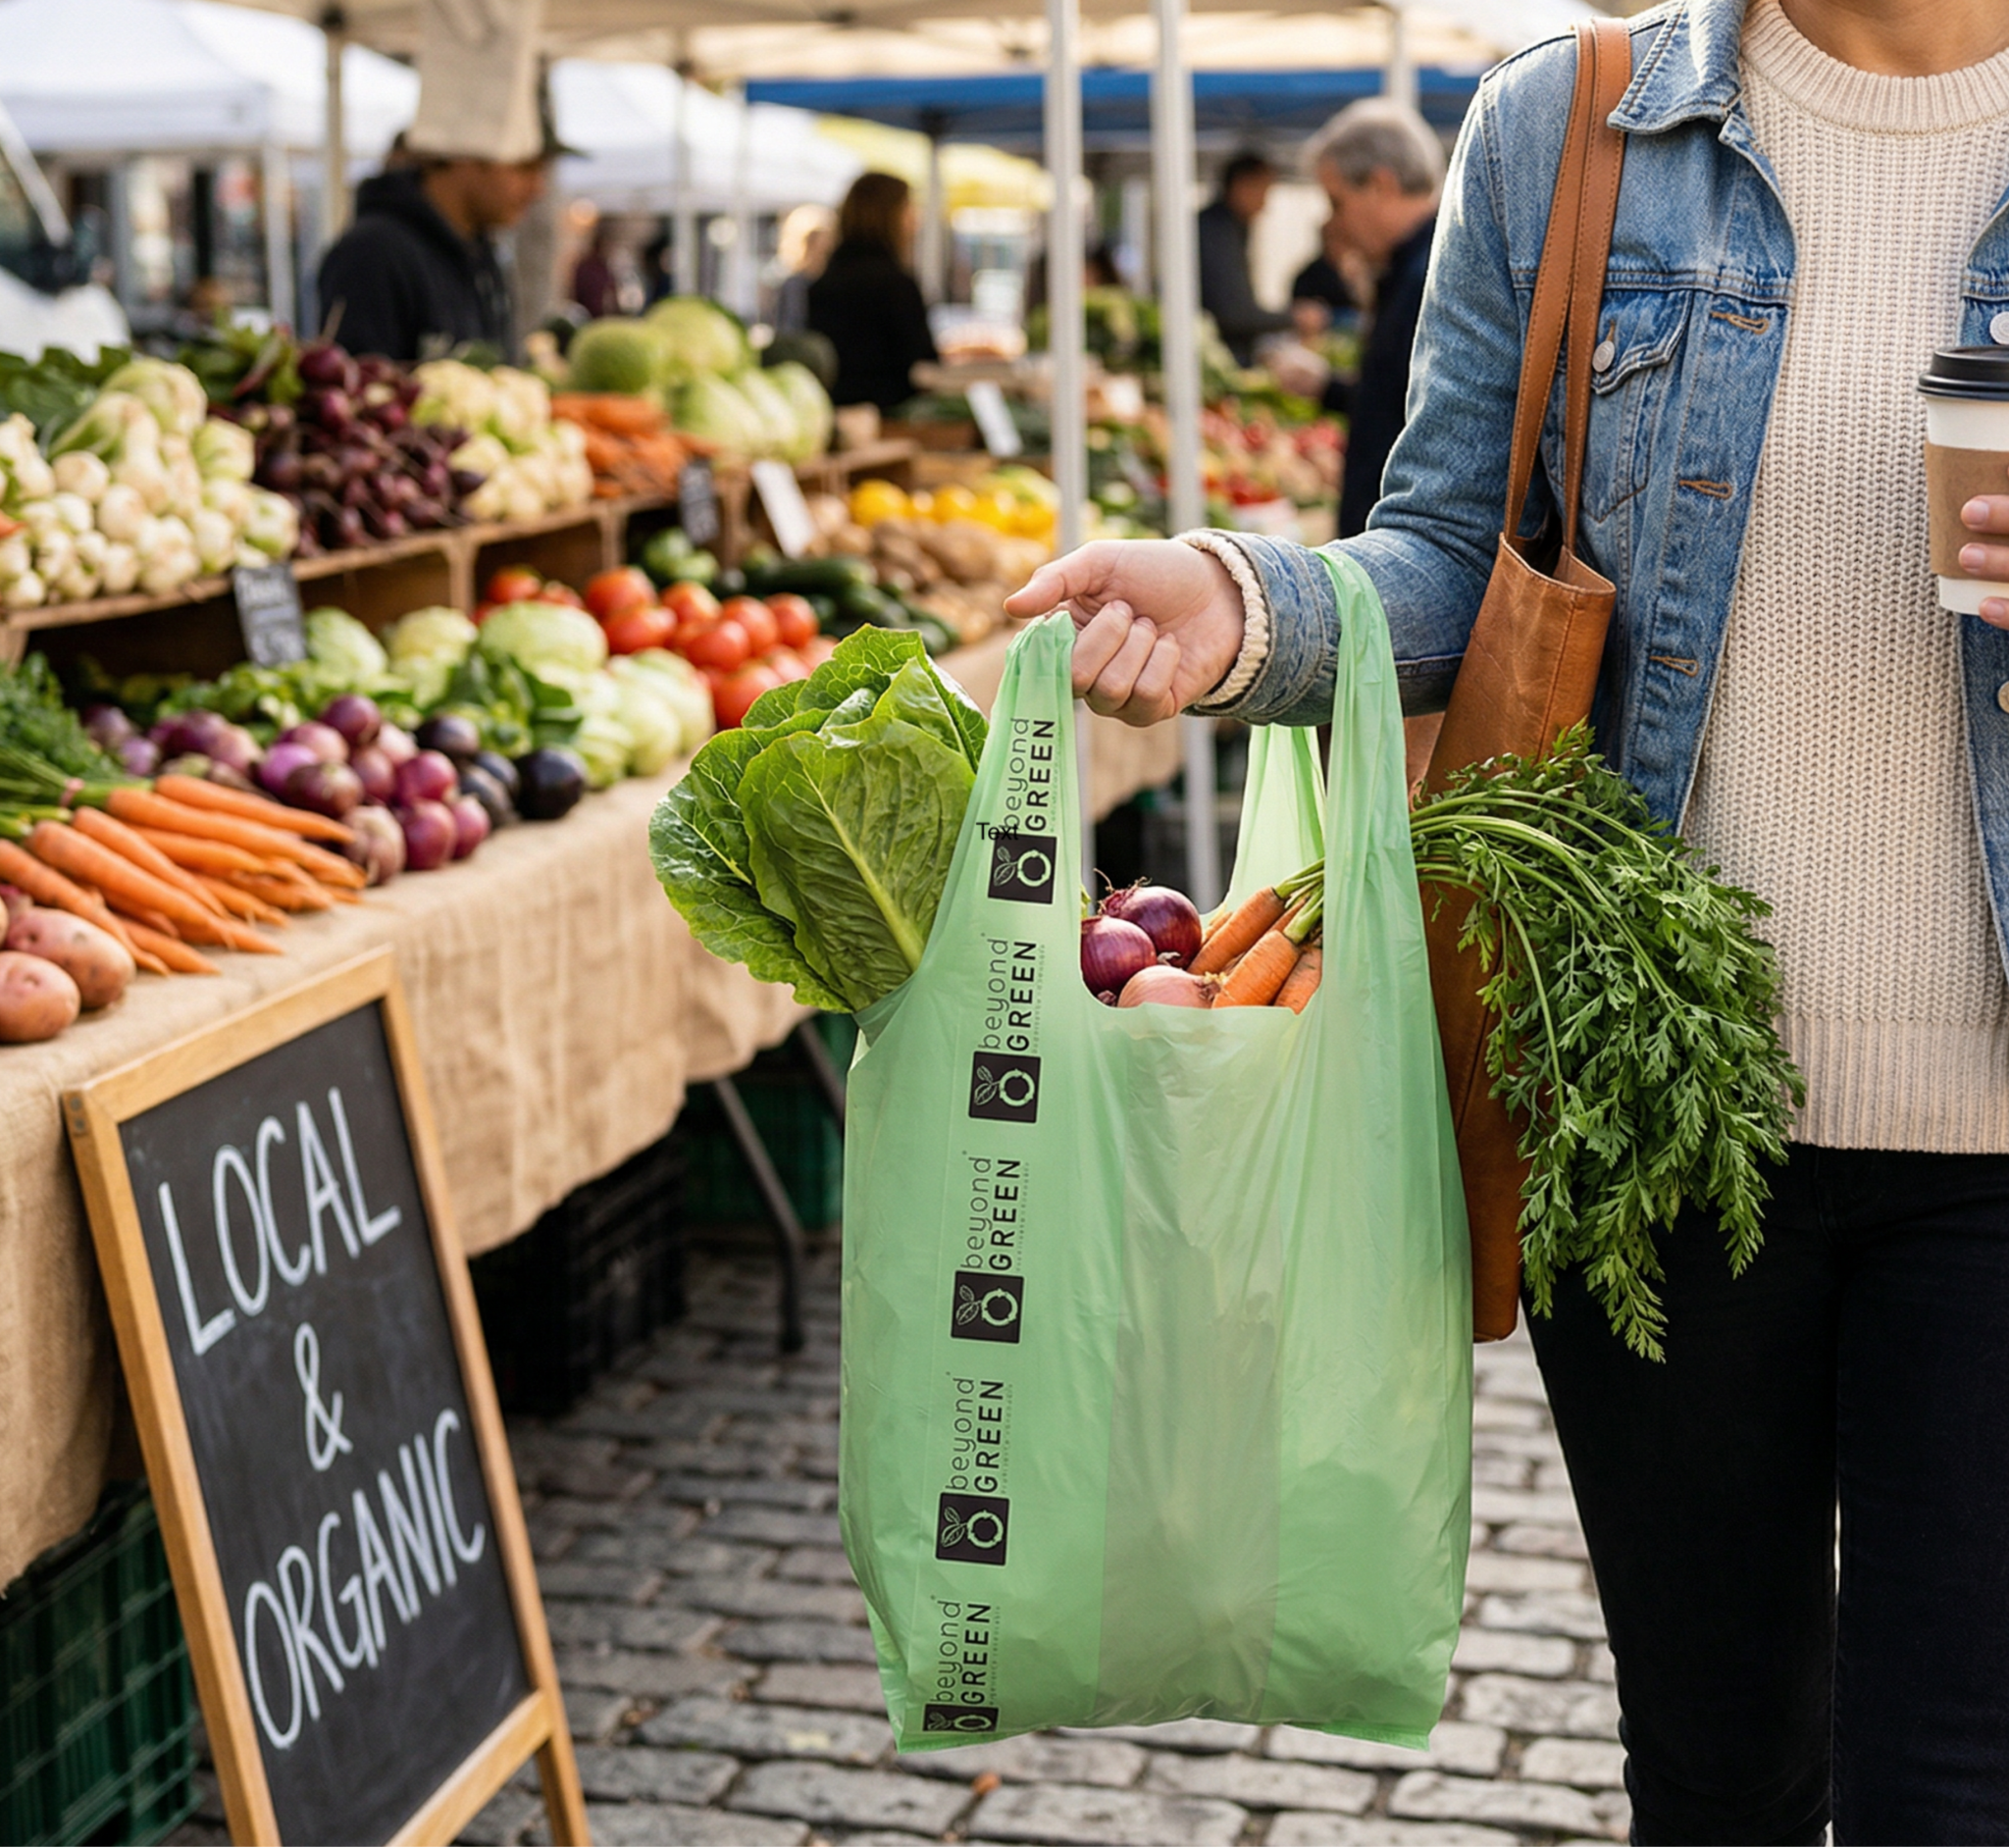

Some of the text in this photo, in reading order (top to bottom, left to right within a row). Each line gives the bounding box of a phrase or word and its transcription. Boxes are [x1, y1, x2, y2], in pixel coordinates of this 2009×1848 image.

[998, 718, 1029, 830] beyond
[1025, 720, 1055, 832] GREEN
[978, 938, 1009, 1050] beyond
[1006, 941, 1037, 1052] GREEN
[158, 1086, 402, 1356] LOCAL
[960, 1156, 993, 1268] beyond
[988, 1159, 1021, 1271] GREEN
[293, 1322, 353, 1471] &
[945, 1377, 977, 1490] beyond
[974, 1380, 1004, 1493] GREEN
[244, 1408, 486, 1750] ORGANIC
[930, 1600, 963, 1702] beyond
[960, 1603, 991, 1705] GREEN
